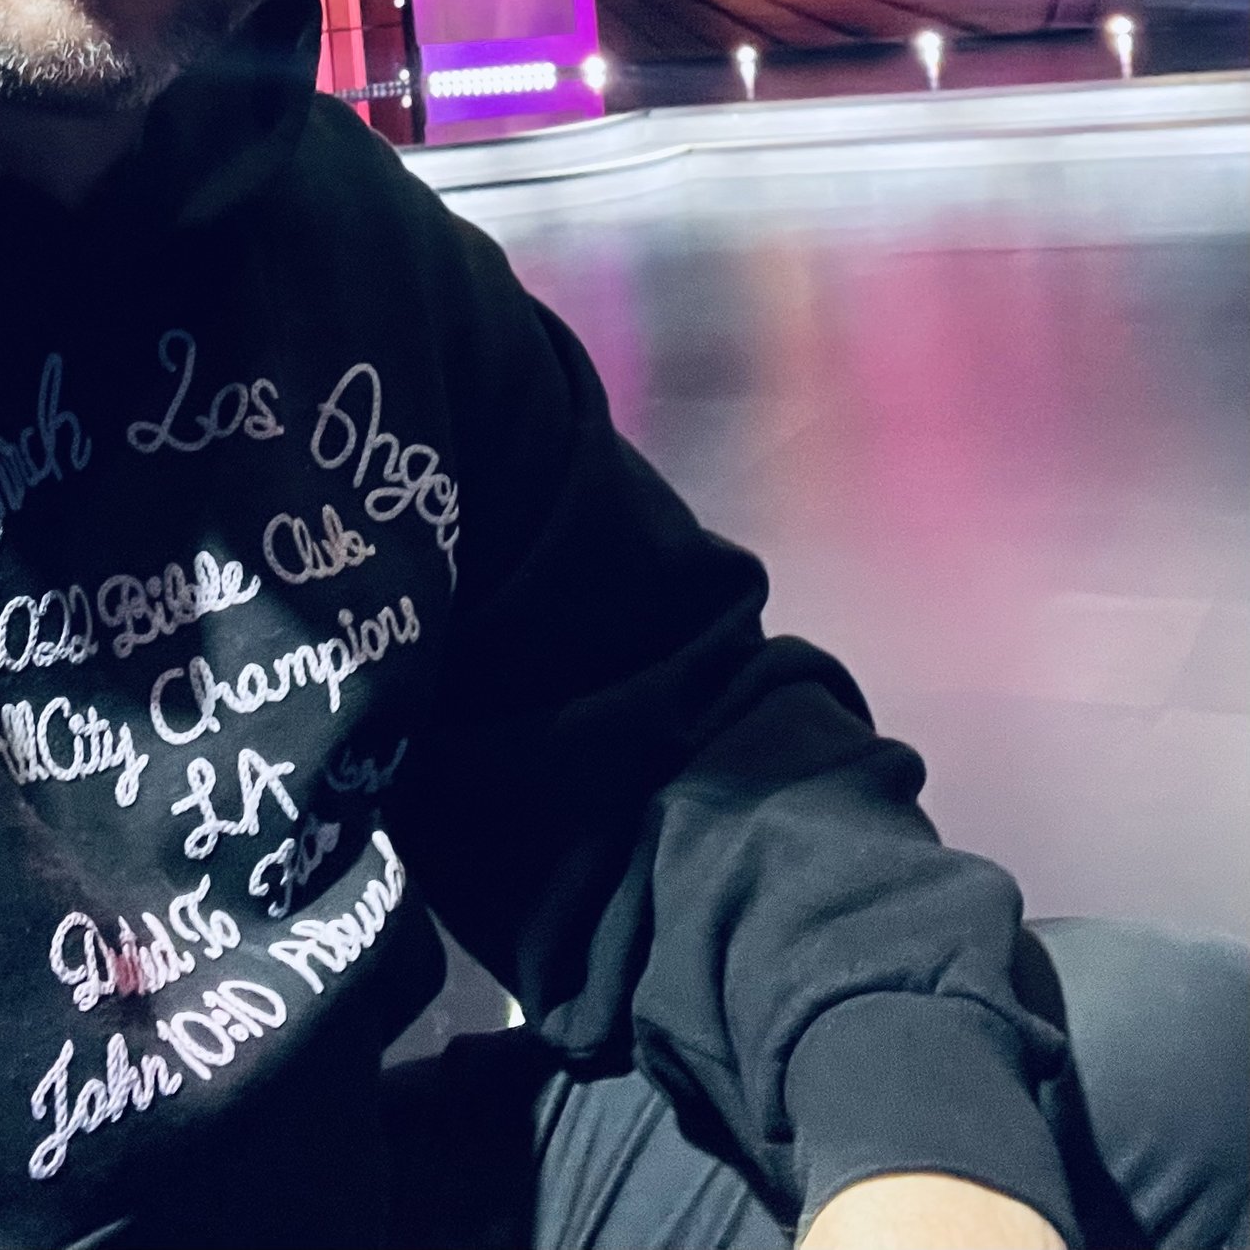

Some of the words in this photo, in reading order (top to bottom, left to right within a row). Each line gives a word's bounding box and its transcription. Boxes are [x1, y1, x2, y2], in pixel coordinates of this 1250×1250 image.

[262, 503, 376, 585] Club
[150, 595, 421, 745] Champions
[171, 748, 300, 860] LA
[29, 1034, 183, 1180] John
[156, 980, 287, 1081] 10:10
